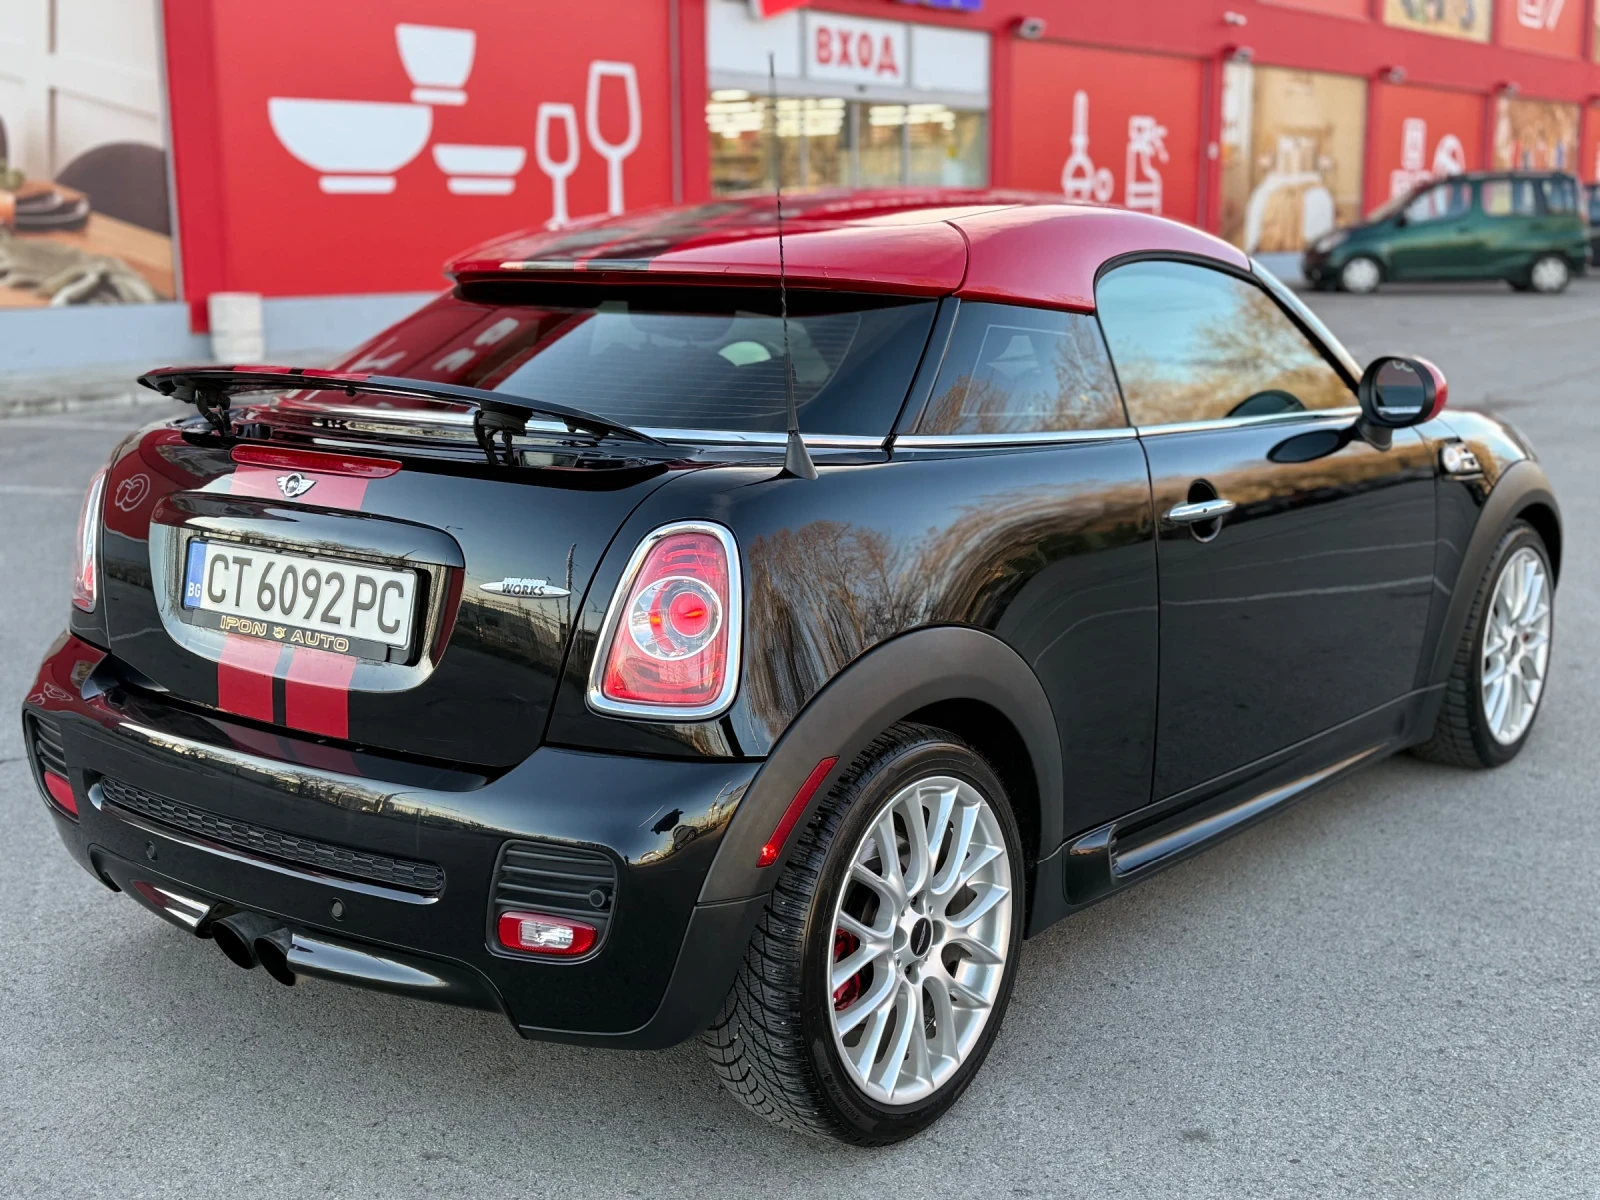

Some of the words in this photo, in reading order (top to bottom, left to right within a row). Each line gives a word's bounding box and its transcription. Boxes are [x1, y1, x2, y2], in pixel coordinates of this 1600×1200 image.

[815, 27, 898, 77] ВХОД
[188, 581, 201, 598] BG
[502, 583, 545, 596] WORKS
[220, 615, 267, 636] IPON
[290, 631, 349, 652] AUTO
